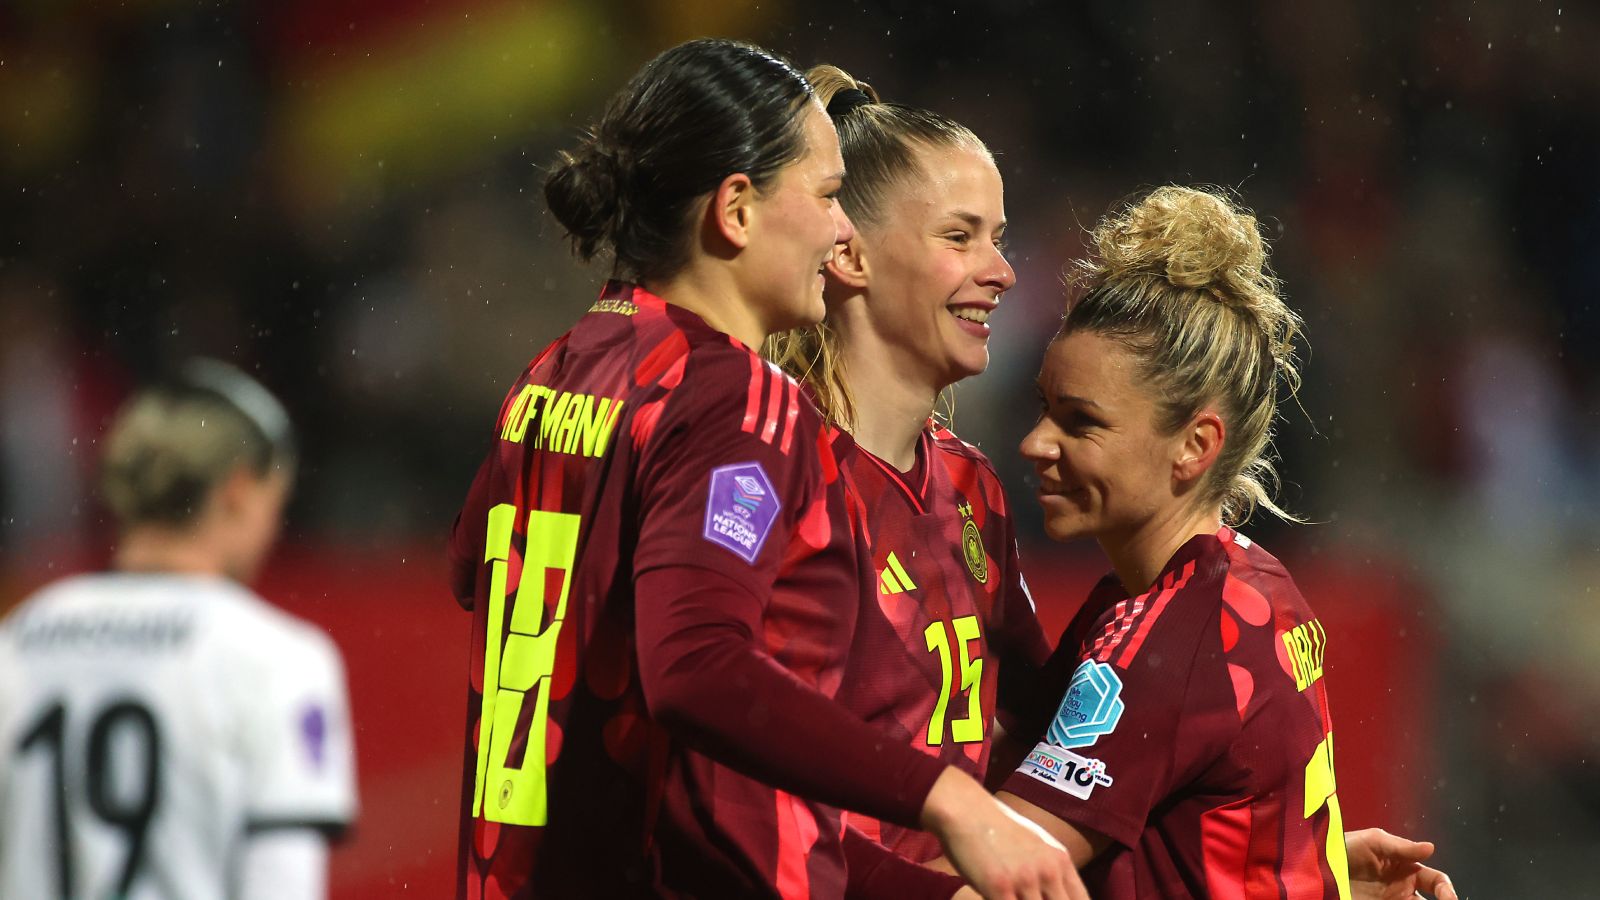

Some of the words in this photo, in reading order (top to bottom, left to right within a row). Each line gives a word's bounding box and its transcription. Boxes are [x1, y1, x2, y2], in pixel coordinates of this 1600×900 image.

[713, 513, 758, 543] NATIONS
[714, 522, 752, 550] LEAGUE
[472, 503, 581, 827] 18
[924, 615, 984, 745] 15
[15, 694, 162, 900] 19
[1064, 760, 1094, 787] 10
